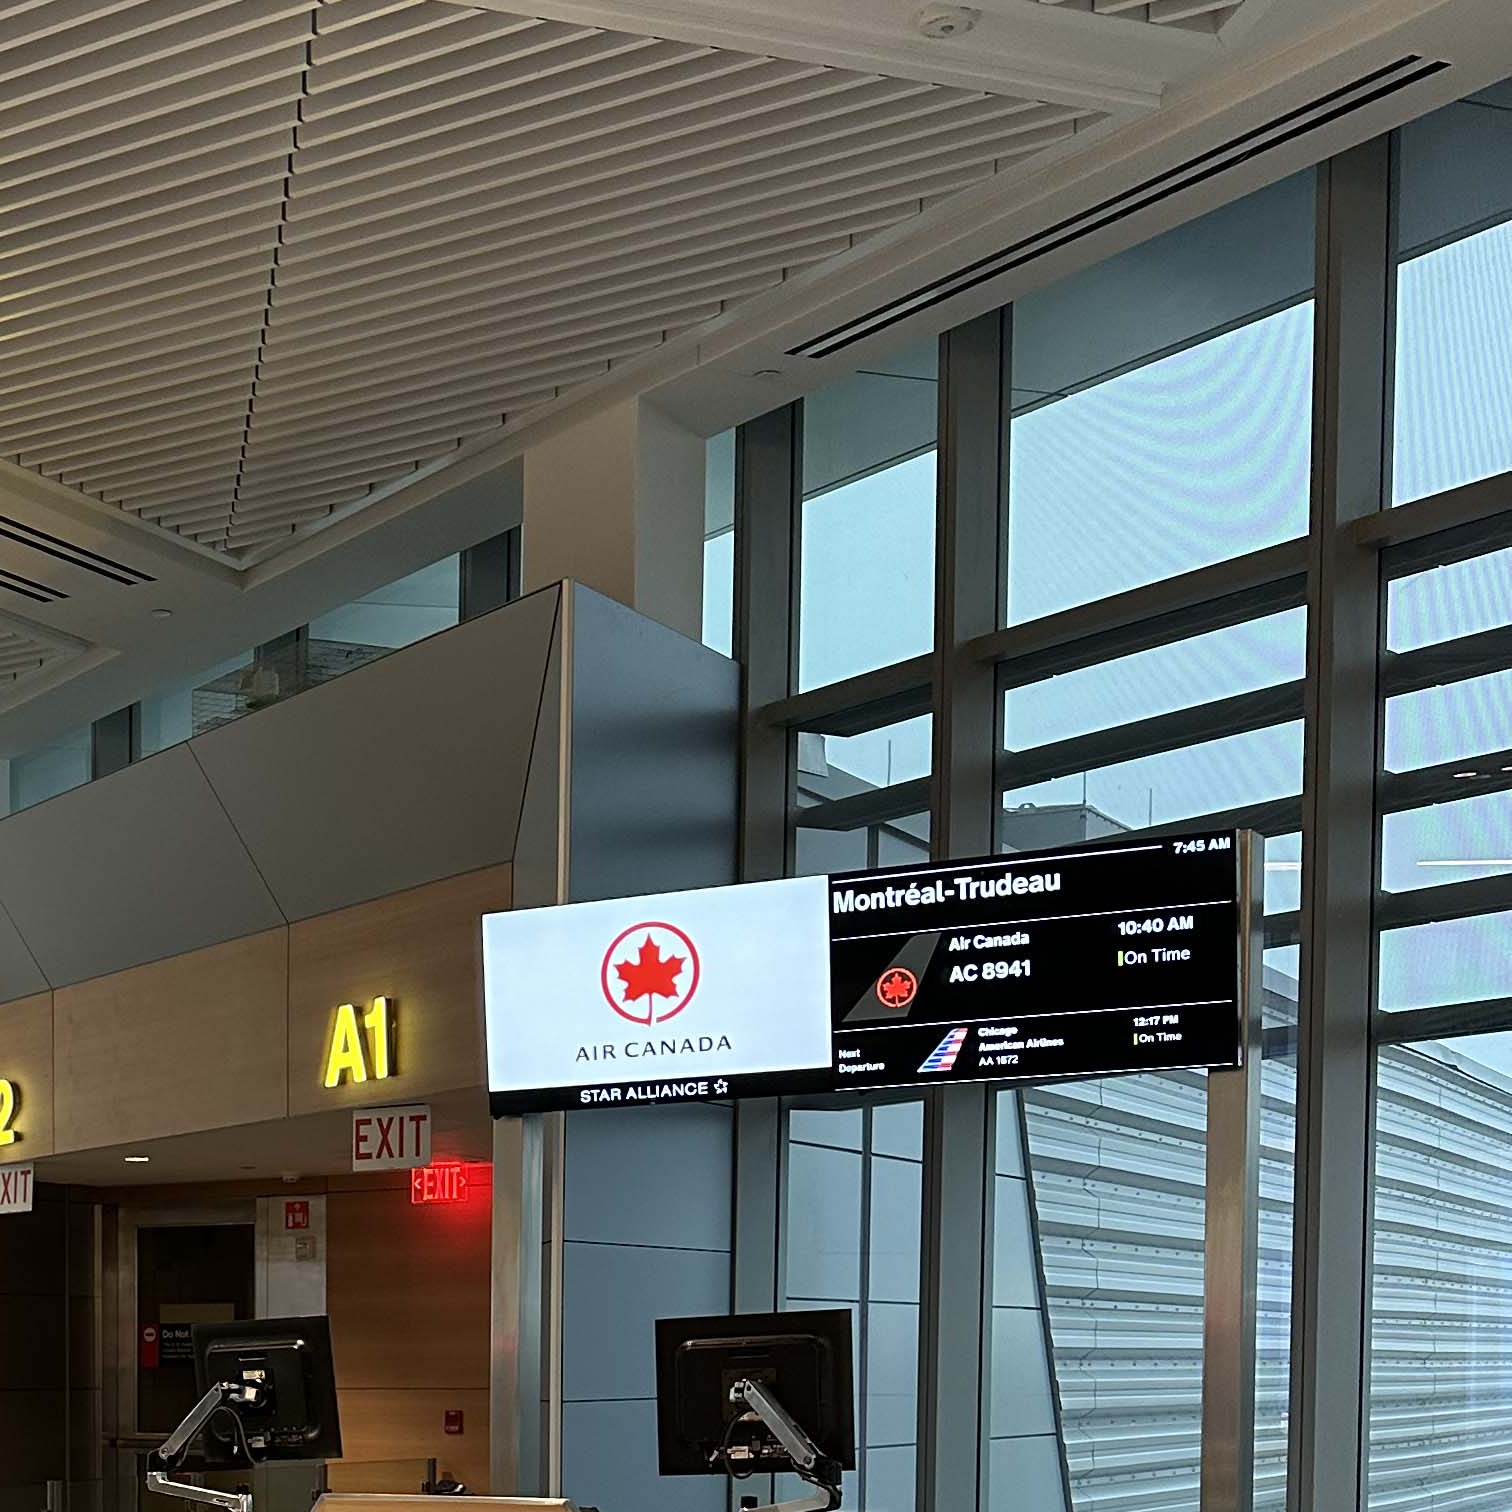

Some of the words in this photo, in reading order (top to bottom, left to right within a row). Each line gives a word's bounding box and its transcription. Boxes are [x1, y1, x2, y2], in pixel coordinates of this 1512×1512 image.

[1173, 841, 1205, 854] 7:45
[1206, 838, 1231, 852] AM
[833, 872, 1061, 914] Montréal-Trudeau
[1118, 919, 1164, 936] 10:40
[1167, 916, 1194, 931] AM
[949, 936, 971, 952] Air
[973, 932, 1030, 950] Canada
[1124, 950, 1147, 965] On
[1151, 947, 1191, 962] Time
[949, 964, 979, 983] AC
[982, 960, 1031, 980] 8941
[1163, 1015, 1179, 1026] PM
[978, 1026, 1019, 1037] Chicago
[1139, 1033, 1155, 1043] On
[1156, 1032, 1182, 1042] Time
[324, 995, 389, 1088] A1
[576, 1044, 617, 1062] AIR
[624, 1035, 732, 1057] CANADA
[978, 1040, 1024, 1052] American
[1026, 1037, 1064, 1049] Airlines
[838, 1048, 861, 1059] Next
[978, 1056, 995, 1066] AA
[838, 1060, 885, 1074] Departure
[580, 1088, 622, 1103] STAR
[626, 1081, 709, 1100] ALLIANCE
[355, 1114, 427, 1160] EXIT
[423, 1167, 461, 1200] EXIT
